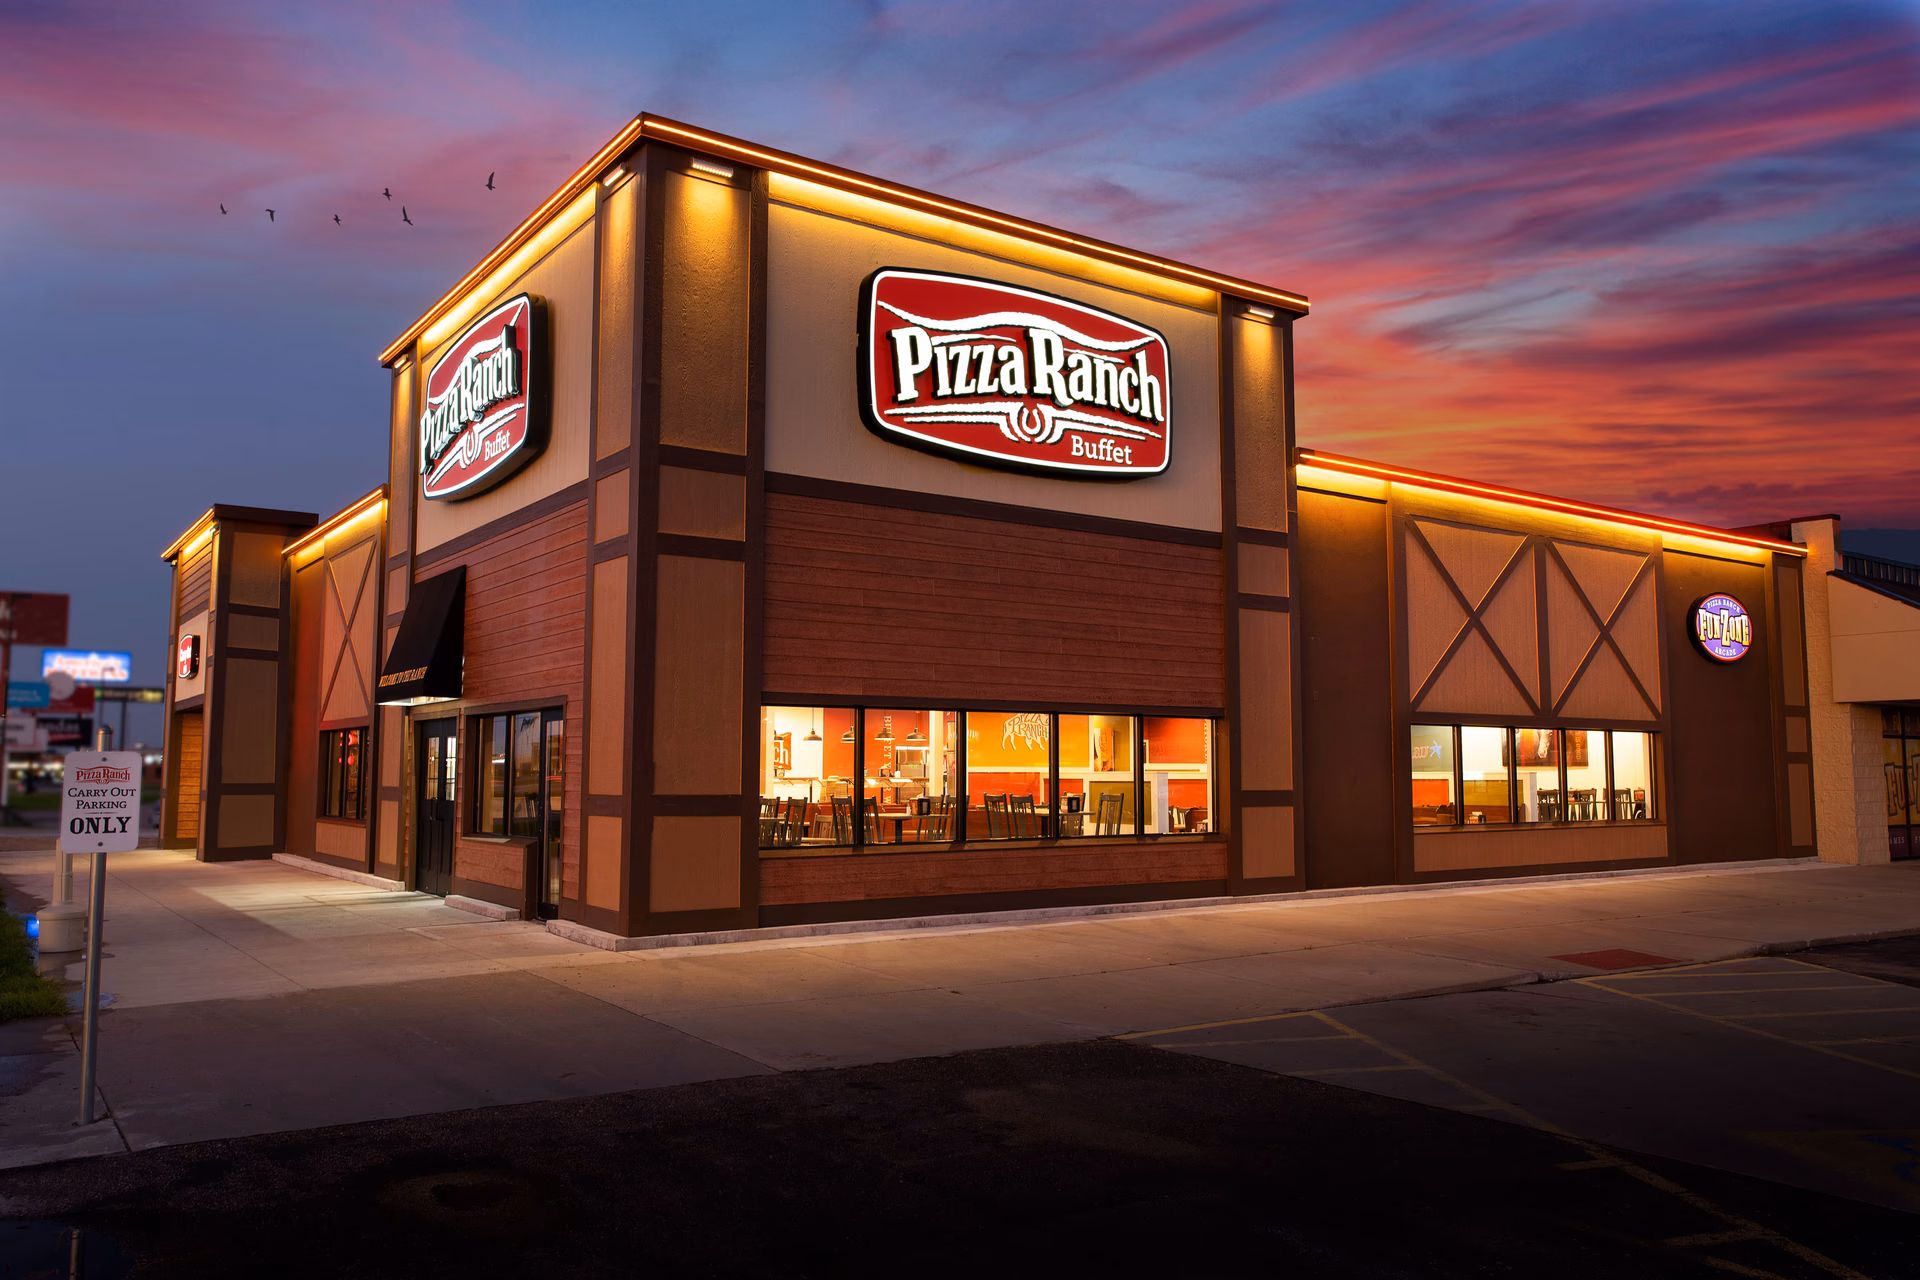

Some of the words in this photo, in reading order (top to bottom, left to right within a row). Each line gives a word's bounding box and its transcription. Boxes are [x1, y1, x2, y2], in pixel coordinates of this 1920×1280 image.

[889, 326, 1028, 403] Pizza
[1024, 328, 1165, 423] Ranch
[420, 385, 461, 475] Pizza
[459, 324, 519, 423] Ranch
[484, 429, 511, 462] Buffet
[1071, 435, 1133, 465] Buffet
[76, 770, 101, 781] Pizza
[102, 768, 131, 781] Ranch
[69, 816, 132, 835] ONLY
